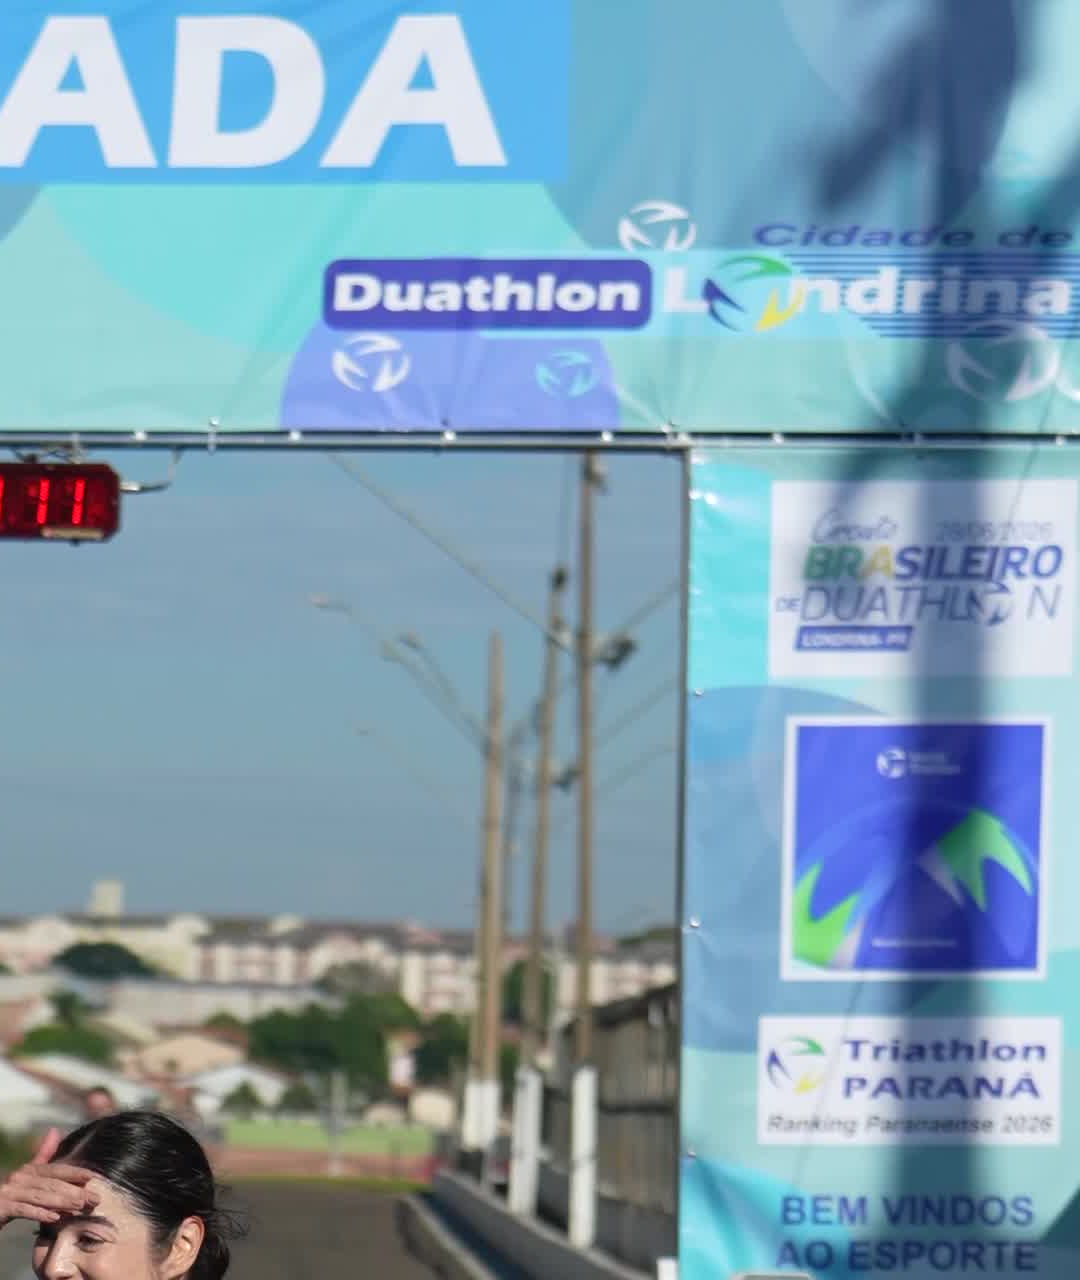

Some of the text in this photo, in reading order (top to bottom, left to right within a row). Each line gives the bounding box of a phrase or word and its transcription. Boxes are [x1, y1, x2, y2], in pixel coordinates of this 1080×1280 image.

[754, 223, 1073, 249] Cidade de
[332, 273, 640, 313] Duathlon
[802, 544, 1064, 581] BRASILEIRO
[843, 1037, 1047, 1062] Triathlon
[843, 1072, 1041, 1099] PARANÁ
[767, 1114, 1054, 1137] Ranking Paranaense 2026
[781, 1195, 1034, 1227] BEM VINDOS
[775, 1240, 1038, 1272] AO ESPORTE
